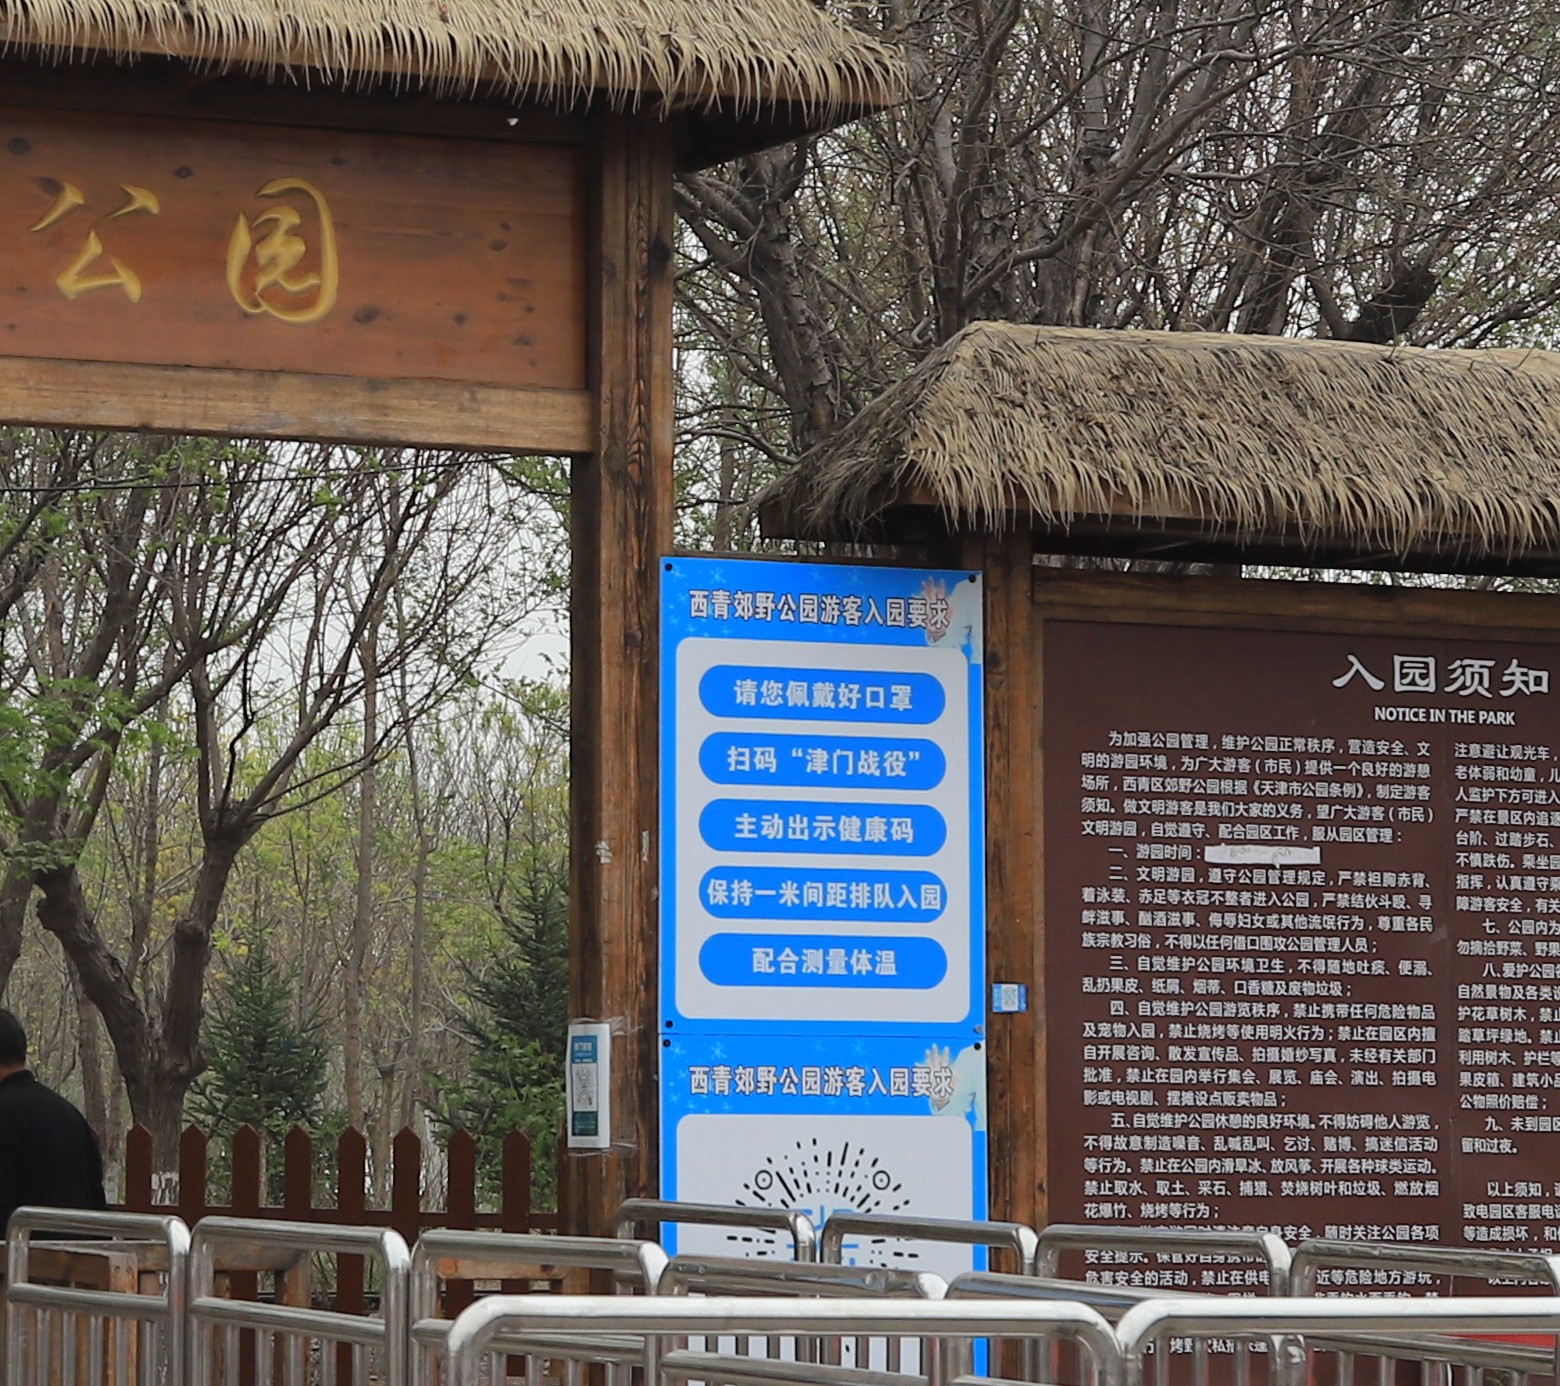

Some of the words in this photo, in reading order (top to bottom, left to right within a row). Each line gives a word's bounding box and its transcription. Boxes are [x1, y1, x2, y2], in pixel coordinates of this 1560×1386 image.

[689, 589, 950, 629] 西青郊野公园游客入园要求
[1332, 654, 1550, 699] 入园须知
[734, 680, 913, 712] 请您佩戴好口罩
[1374, 706, 1427, 722] NOTICE
[1429, 708, 1446, 723] IN
[1449, 709, 1476, 724] THE
[1479, 710, 1516, 725] PARK
[1108, 730, 1431, 757] 为加强公园管理，维护公园正常秩序，营造安全、文
[734, 814, 914, 844] 主动出示健康码
[1108, 843, 1202, 861] 一、游园时间：
[707, 879, 941, 911] 保持一米间距排队入园
[752, 947, 897, 976] 配合测量体温
[689, 1065, 954, 1097] 西青郊野公园游客入园要求
[1461, 1138, 1518, 1154] 留和过夜。
[1084, 1269, 1441, 1287] 危害安全的活动，禁止在供电近等危险地方游玩，
